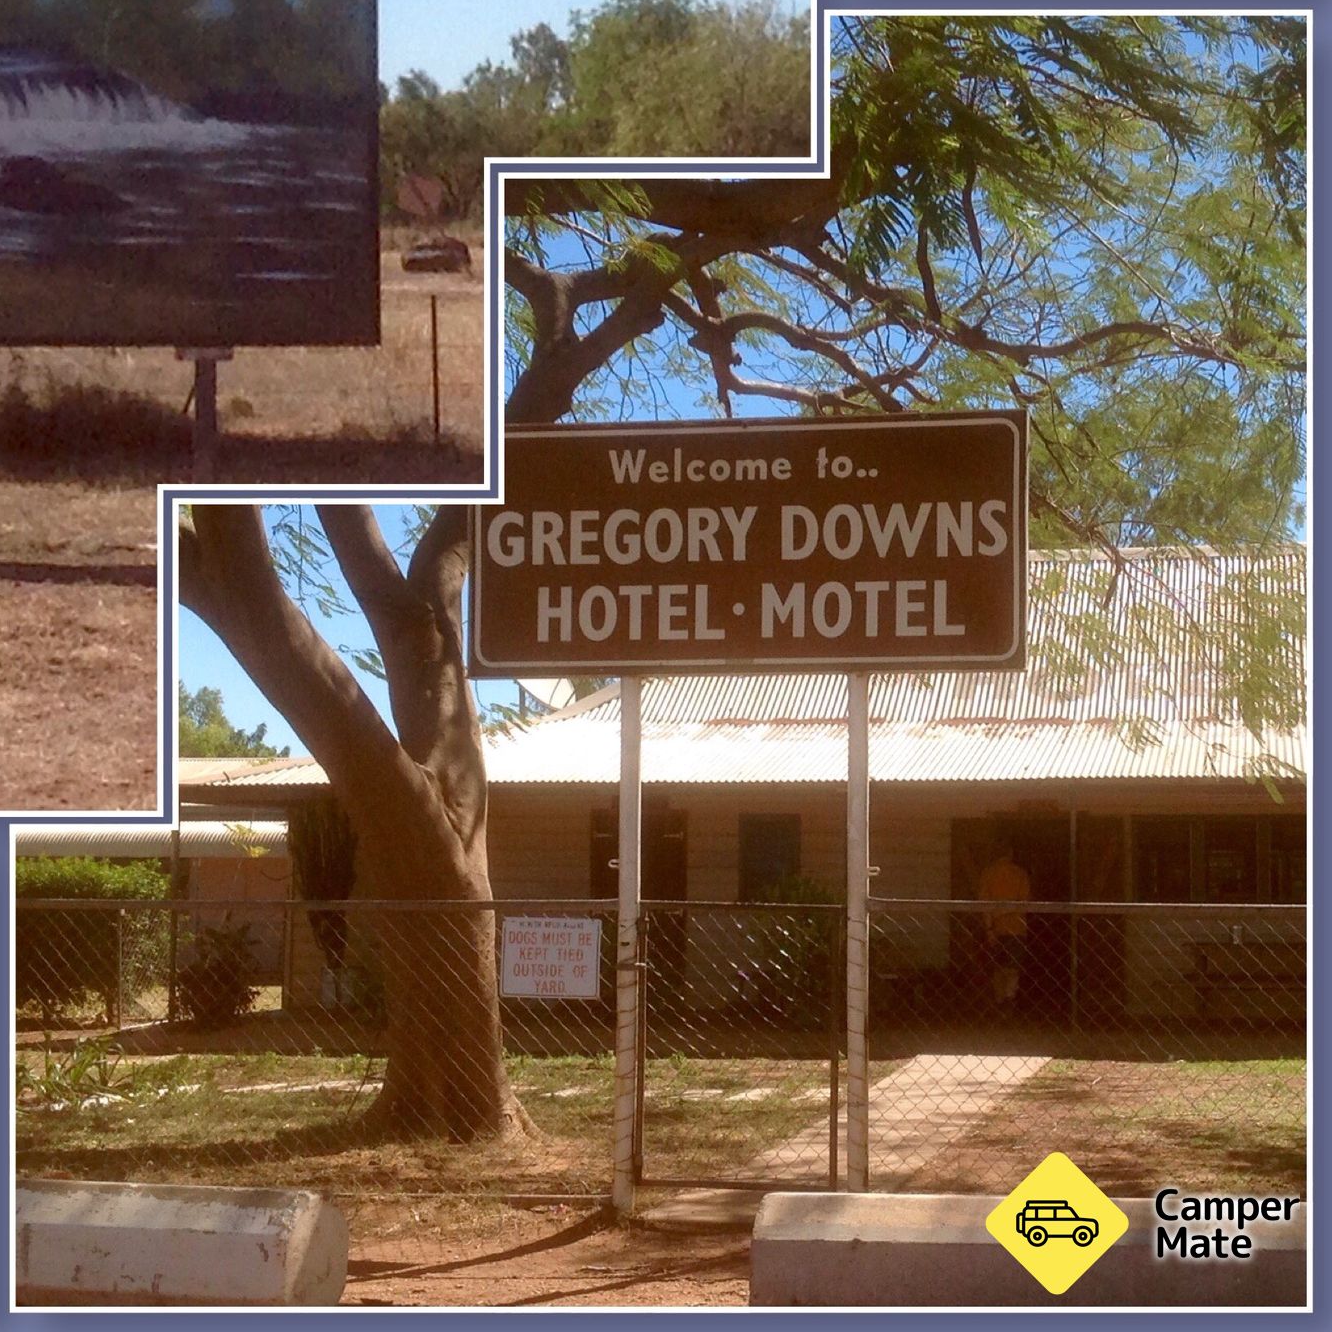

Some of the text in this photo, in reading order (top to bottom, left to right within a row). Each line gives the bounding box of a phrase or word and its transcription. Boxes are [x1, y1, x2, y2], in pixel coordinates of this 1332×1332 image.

[608, 446, 793, 485] Welcome
[486, 499, 1009, 568] GREGORY DOWNS
[508, 931, 593, 947] DOGS MUST BE
[519, 947, 585, 962] KEPT TIED
[513, 963, 589, 979] OUTSIDE OF
